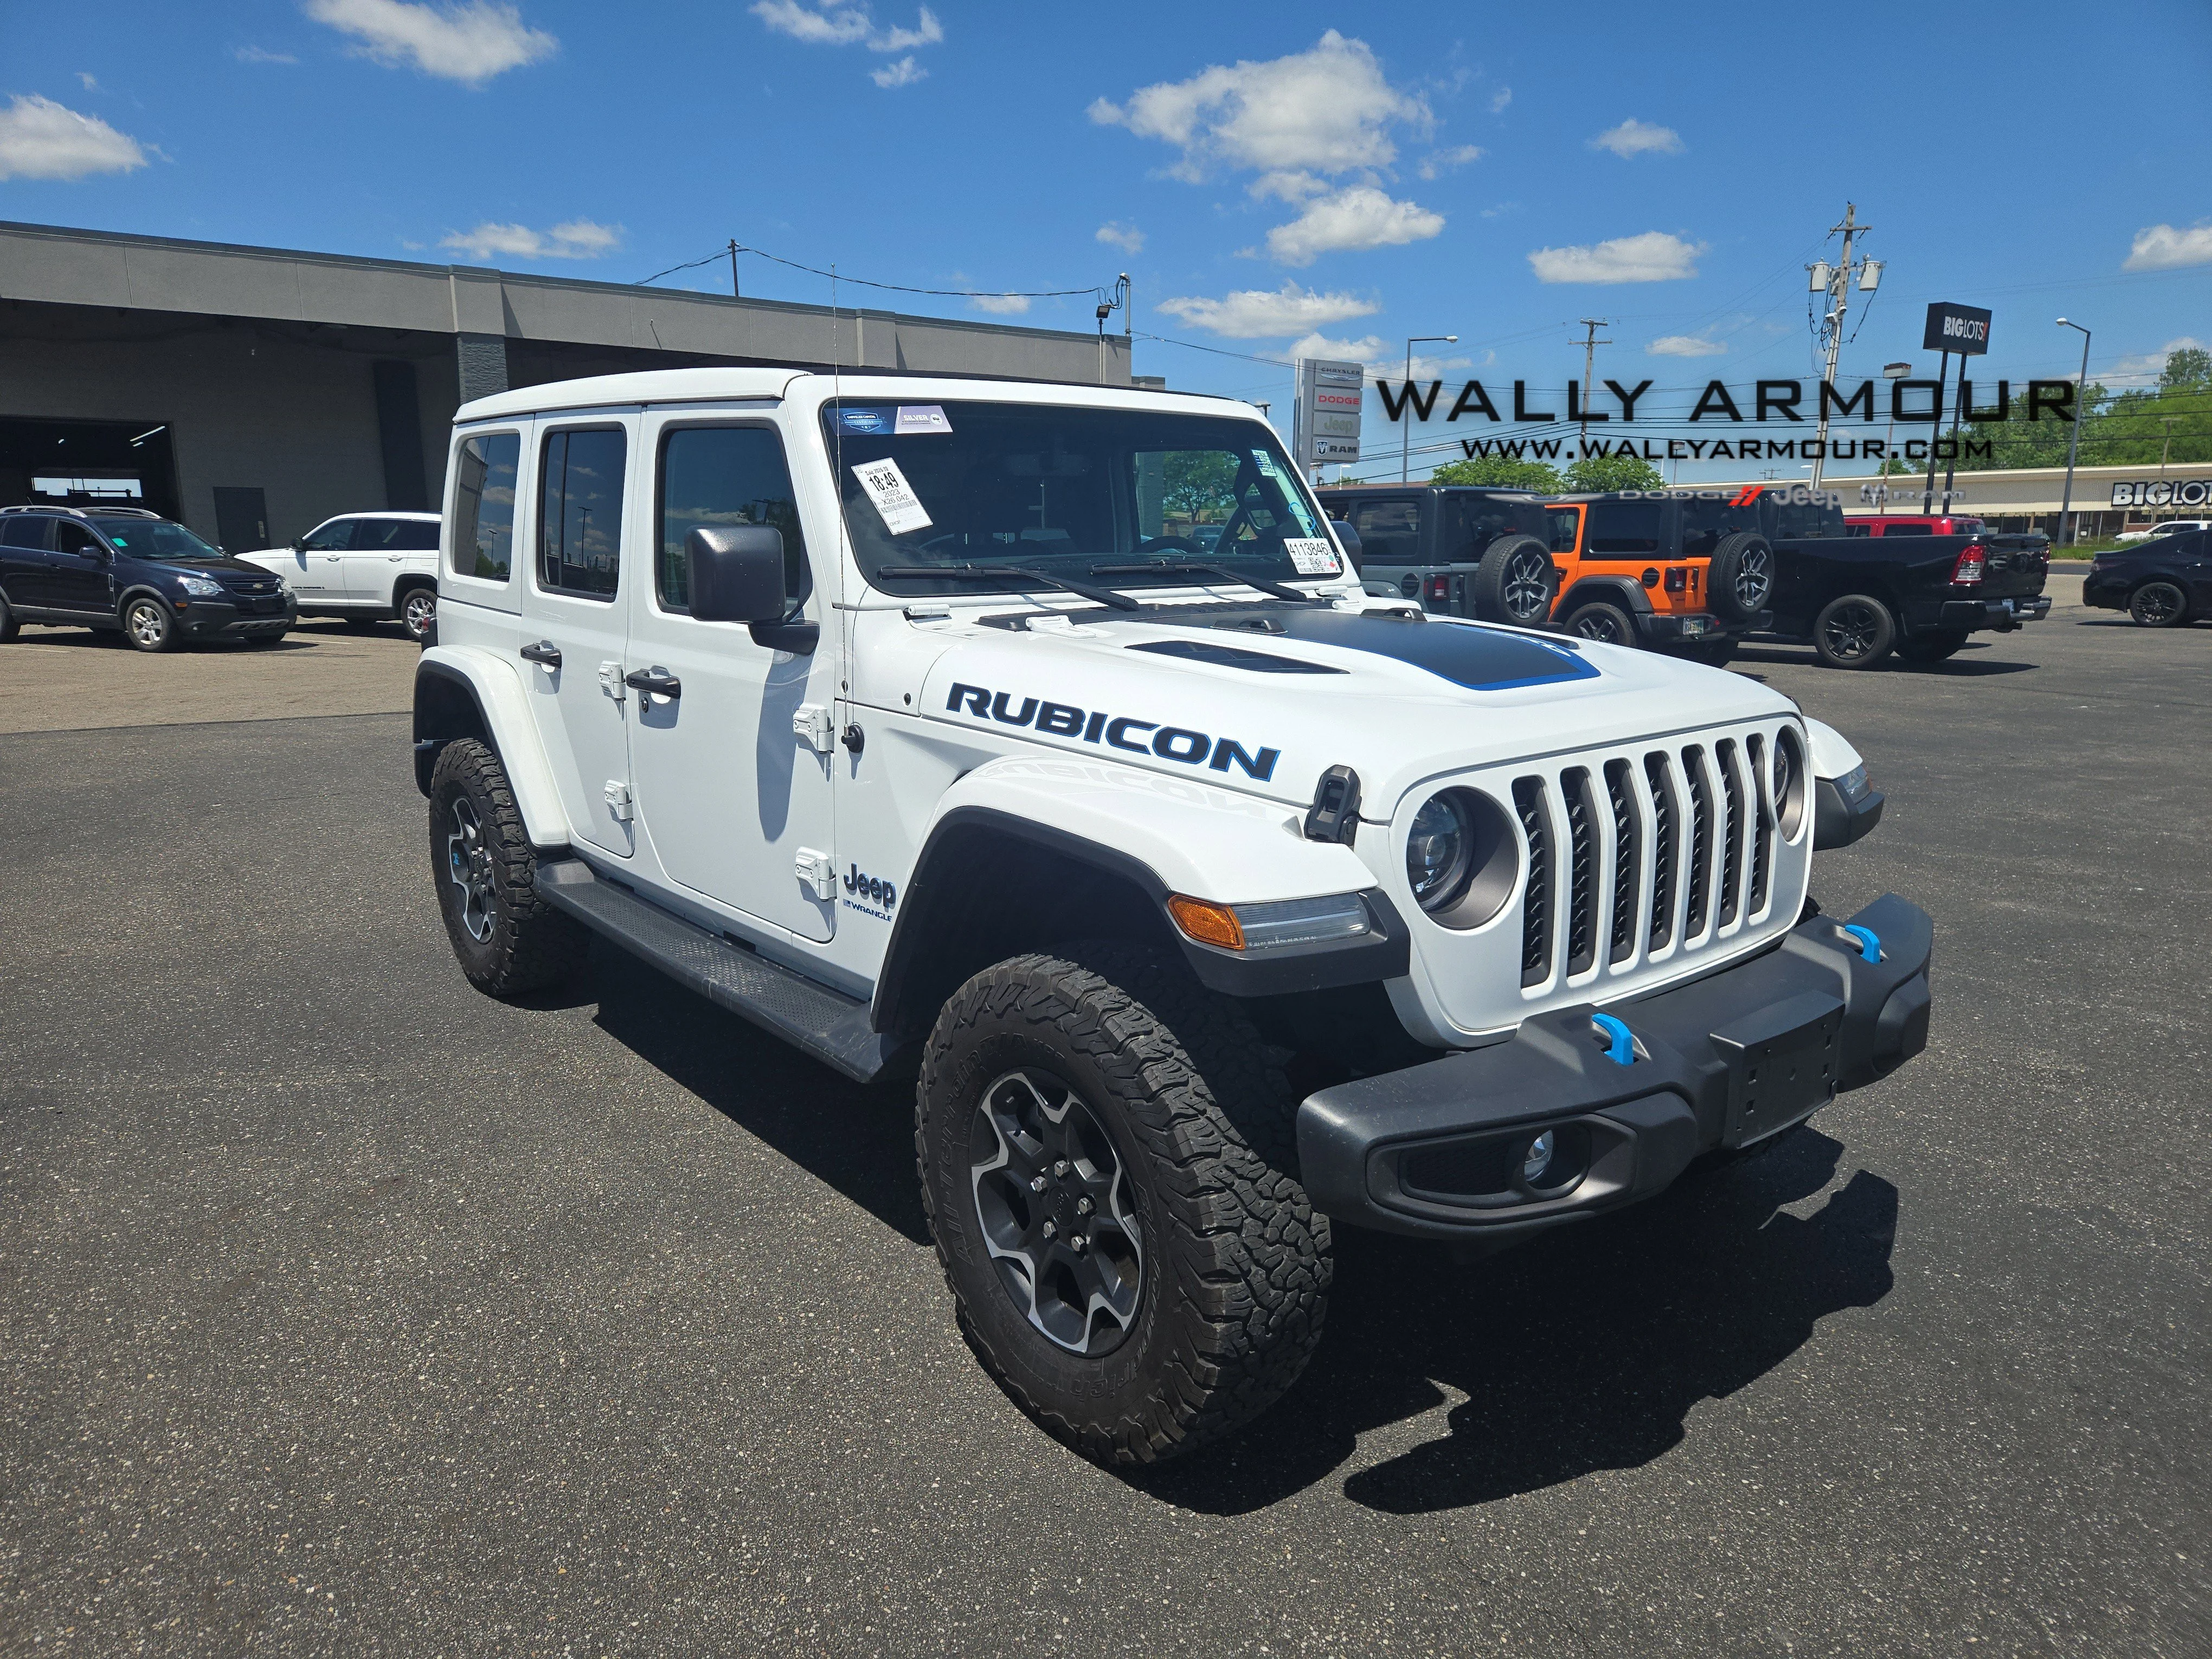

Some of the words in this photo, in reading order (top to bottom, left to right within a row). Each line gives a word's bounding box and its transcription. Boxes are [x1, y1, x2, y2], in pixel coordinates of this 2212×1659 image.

[1321, 367, 1360, 375] CHRYSLER
[1319, 395, 1360, 405] DODGE
[1324, 415, 1353, 434] Jeep
[1329, 445, 1357, 454] RAM
[869, 472, 899, 492] 18:49
[883, 488, 901, 498] 2023
[1290, 542, 1329, 556] 4113846
[946, 682, 1281, 782] RUBICON
[843, 863, 897, 909] Jeep
